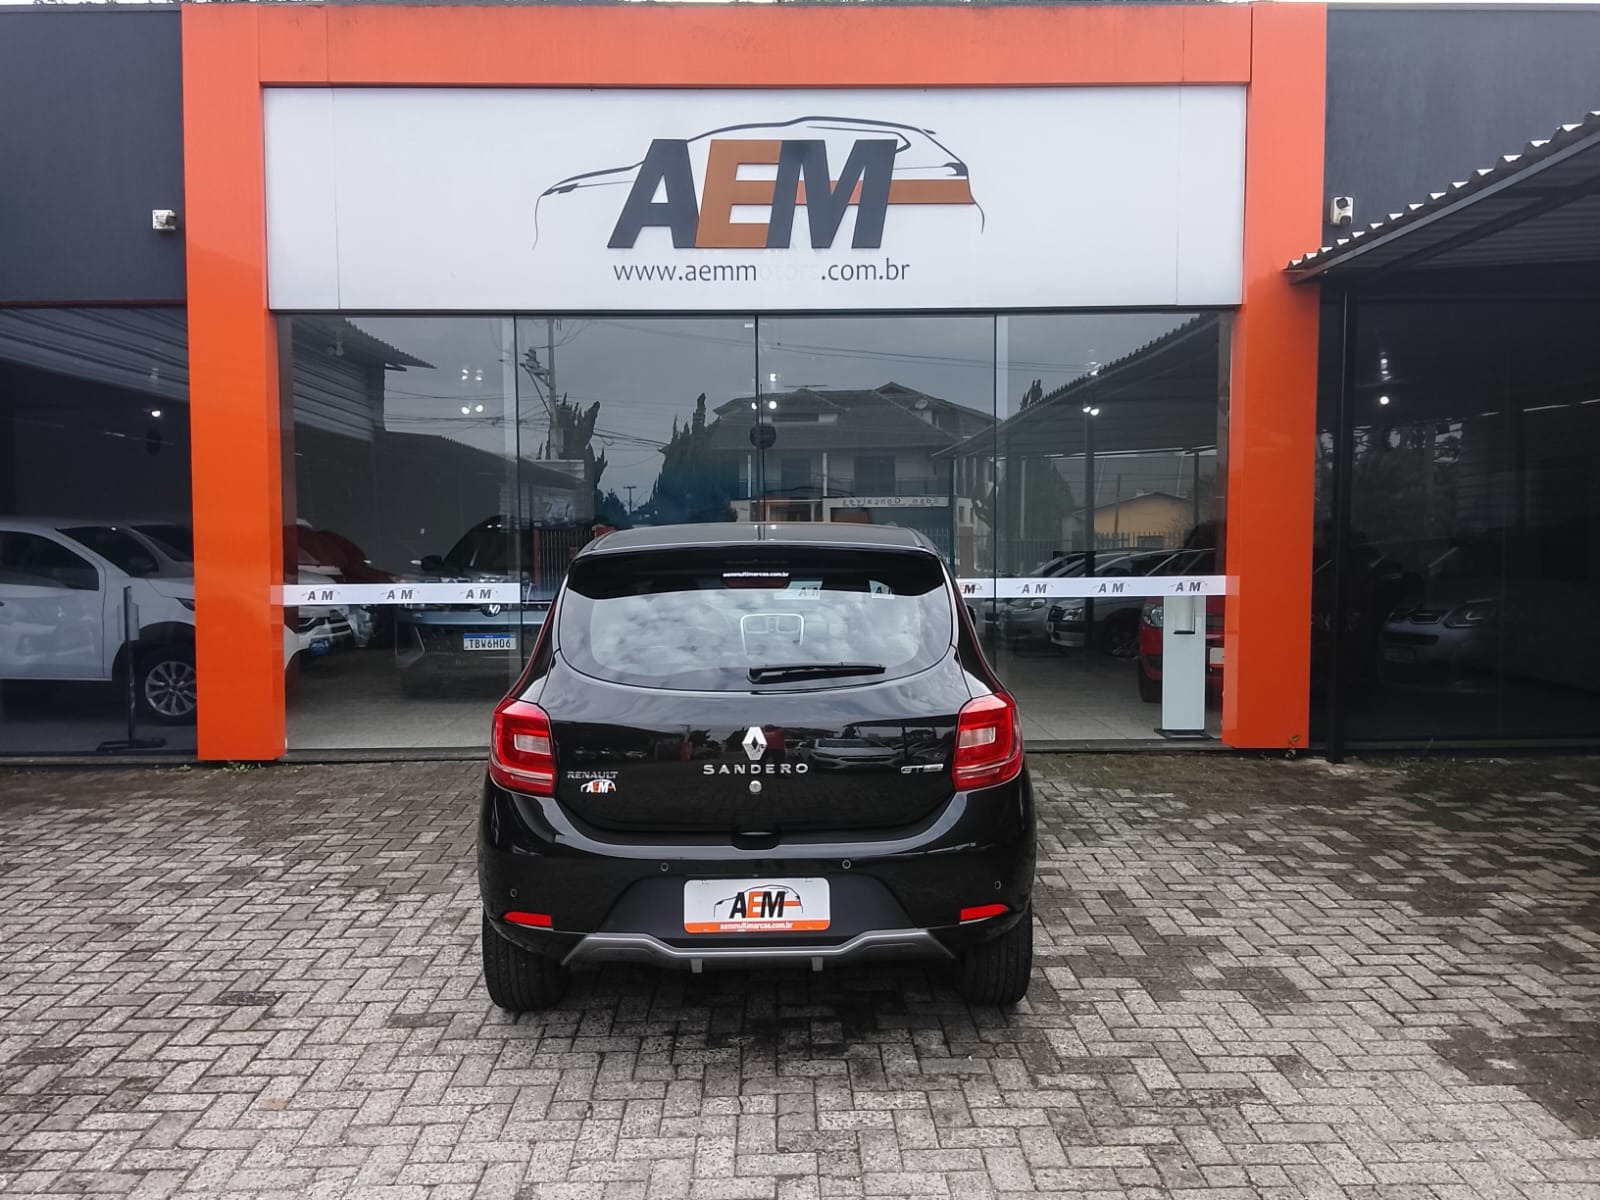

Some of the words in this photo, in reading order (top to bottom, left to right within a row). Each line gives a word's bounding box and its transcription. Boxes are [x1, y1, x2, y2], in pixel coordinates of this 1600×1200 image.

[607, 139, 898, 248] AEM
[567, 771, 619, 779] RENAULT
[702, 763, 809, 775] SANDERO
[729, 890, 787, 919] AEM
